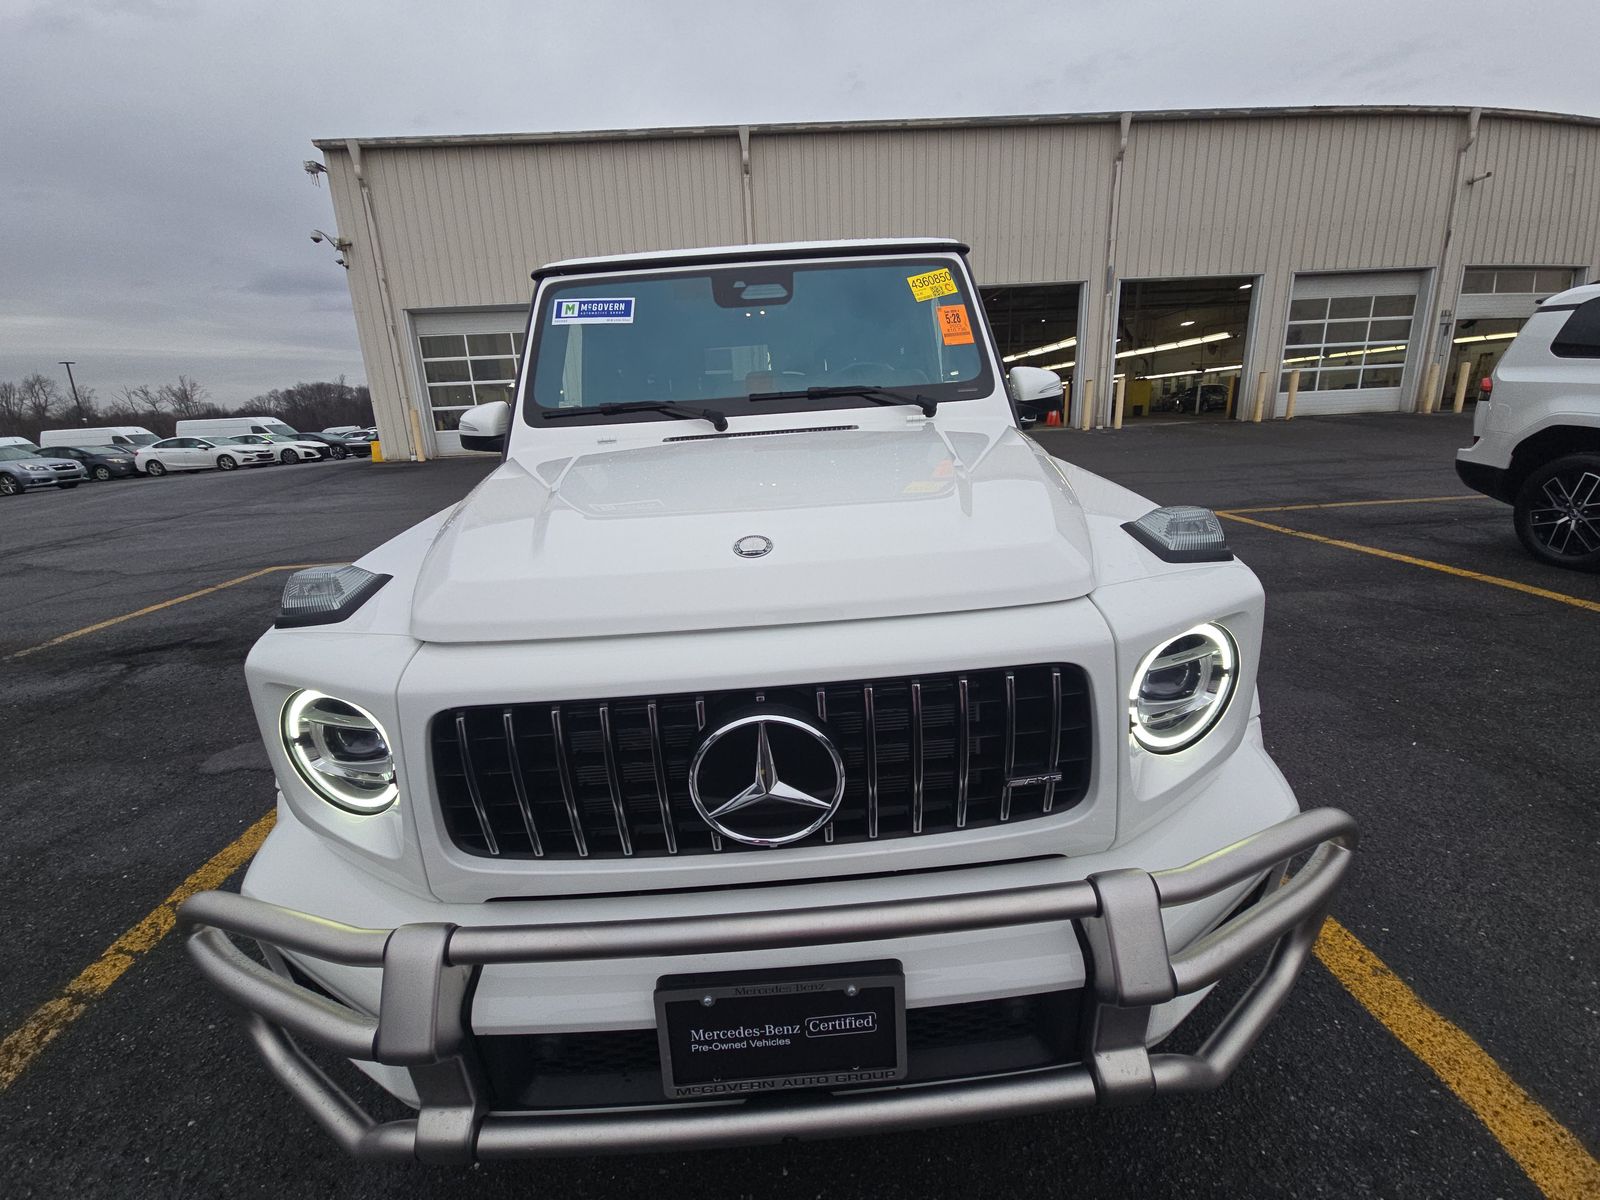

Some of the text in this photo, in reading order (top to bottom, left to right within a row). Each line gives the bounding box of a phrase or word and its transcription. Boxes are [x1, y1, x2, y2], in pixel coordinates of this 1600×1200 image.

[911, 271, 952, 288] 4360850
[564, 303, 576, 315] M
[690, 1015, 873, 1042] Mercedes-Benz Certified
[691, 1037, 791, 1052] Pre-Owned Vehicles
[782, 1075, 829, 1087] AUTO
[835, 1070, 896, 1083] GROUP
